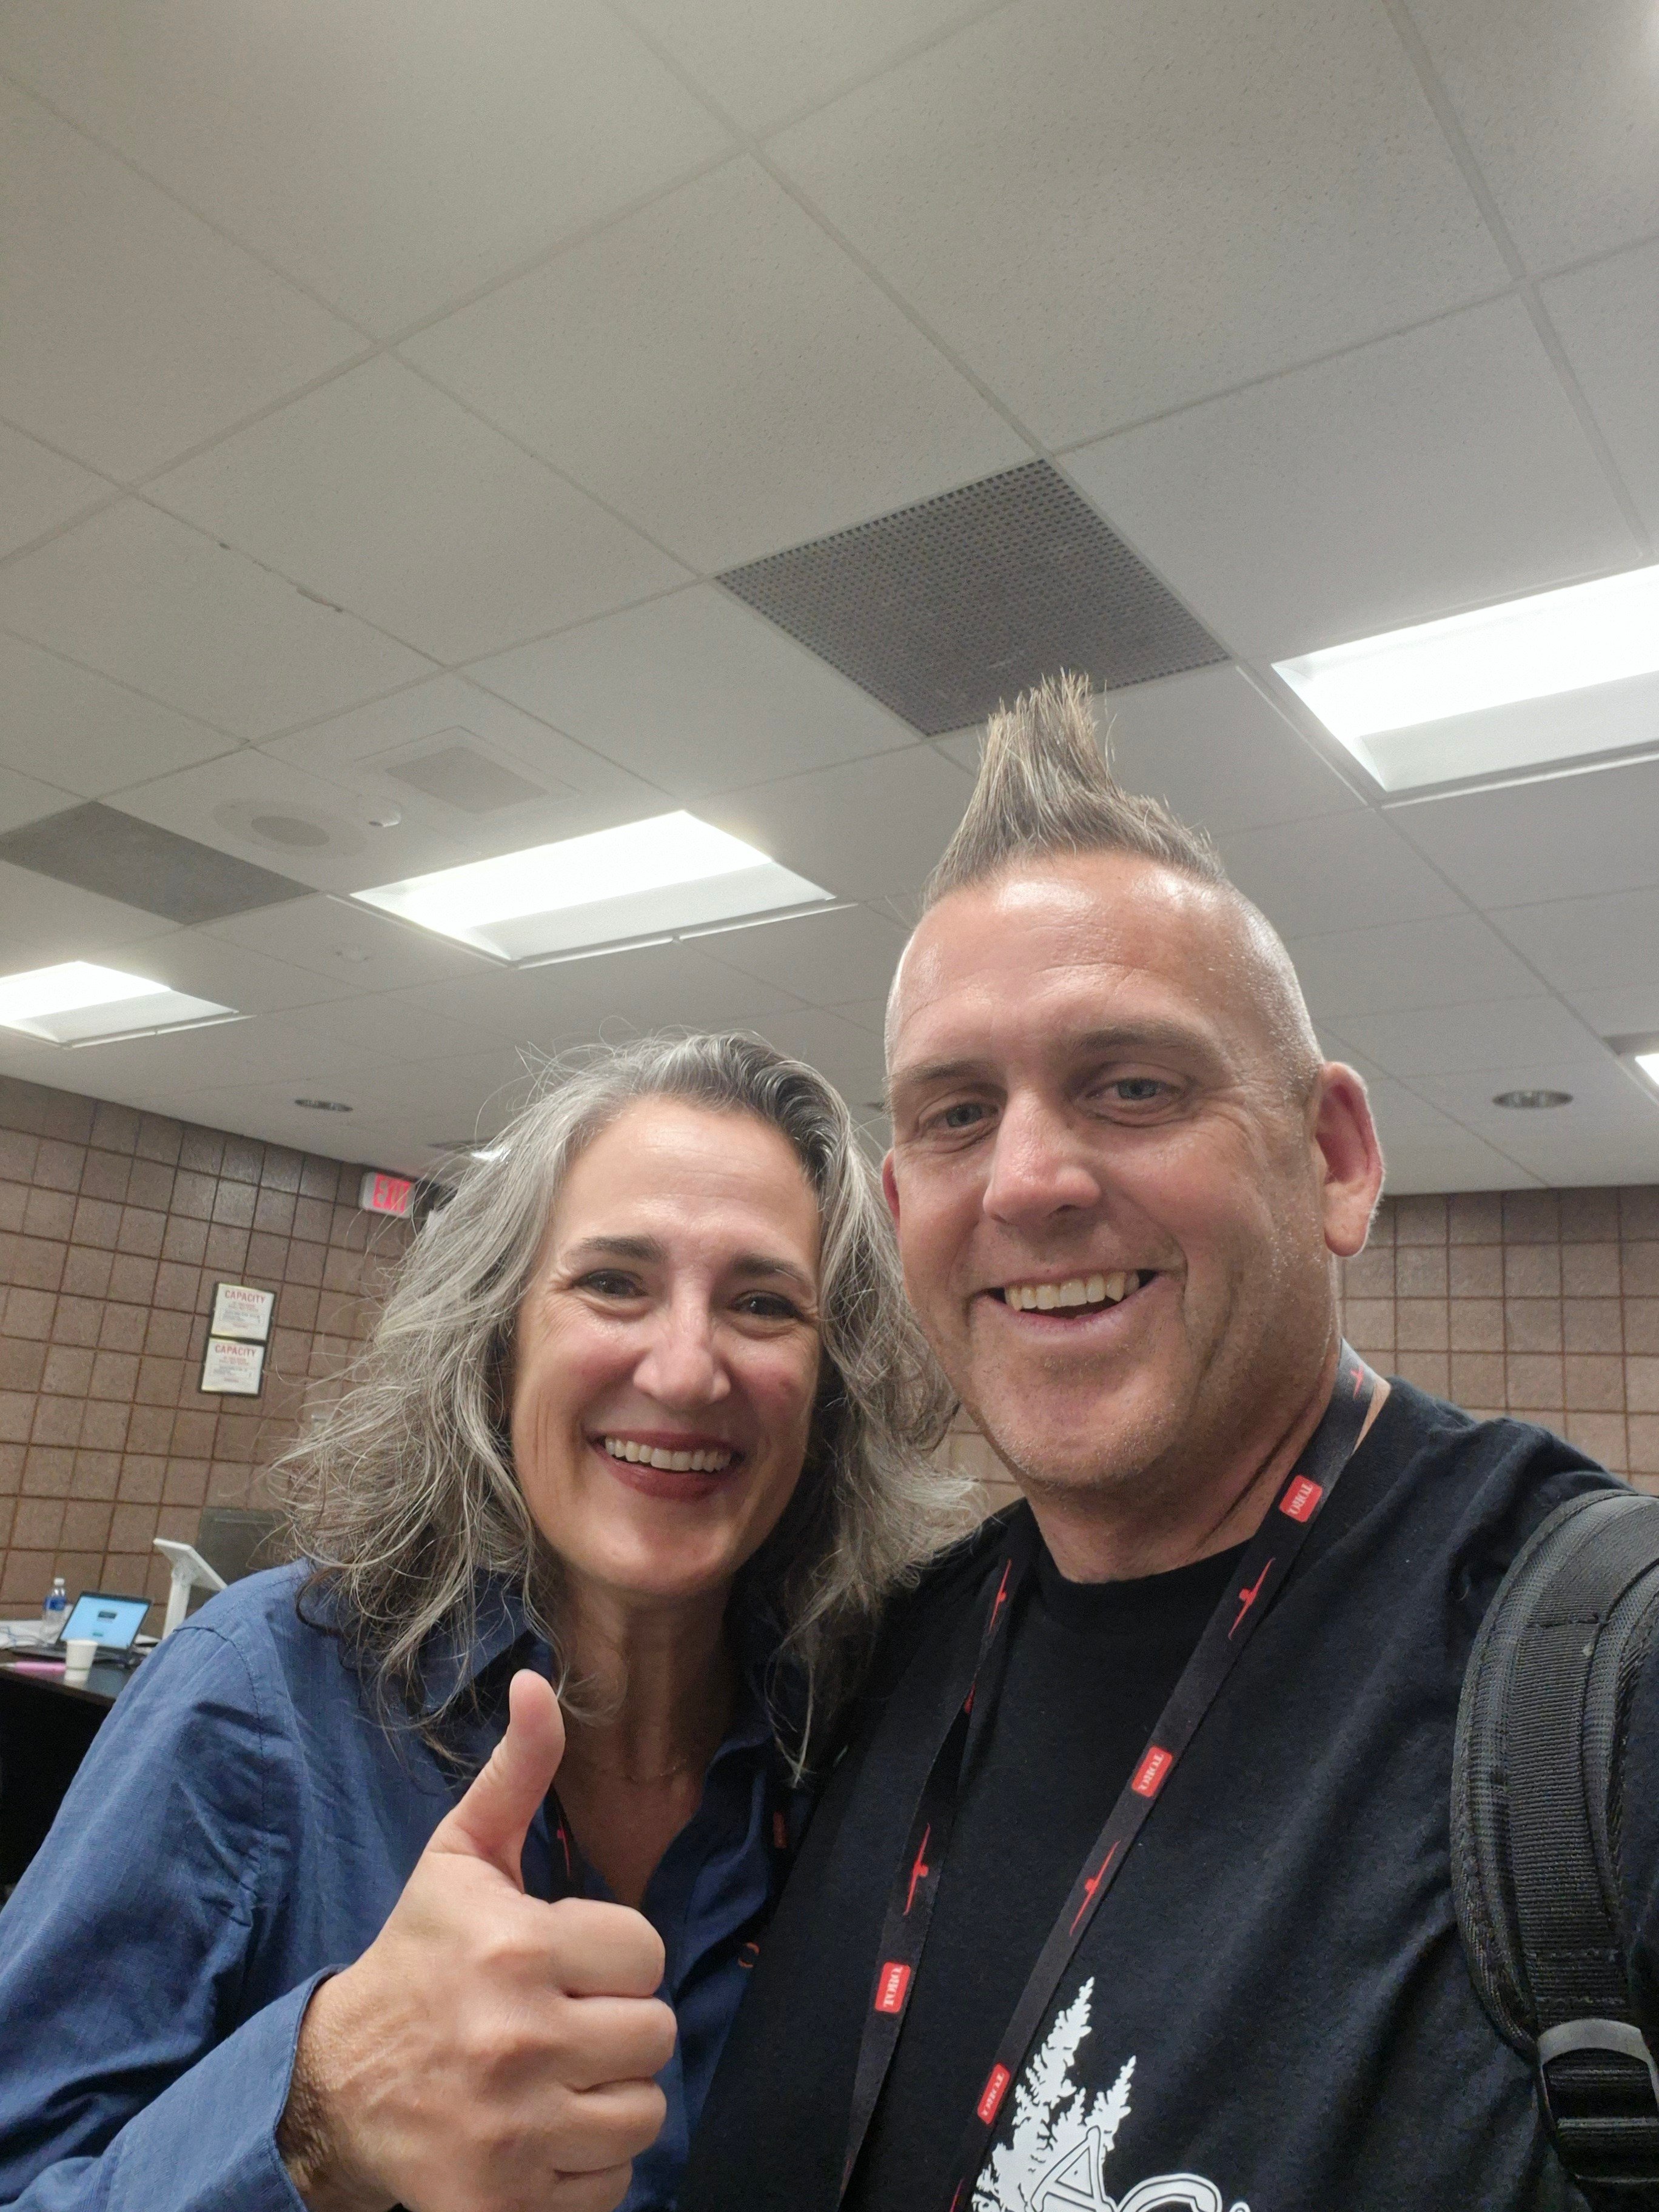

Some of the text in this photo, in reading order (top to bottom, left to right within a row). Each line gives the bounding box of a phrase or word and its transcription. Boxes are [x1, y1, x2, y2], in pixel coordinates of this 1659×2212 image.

[373, 1173, 411, 1214] EXIT
[225, 1290, 266, 1304] CAPACITY
[215, 1344, 257, 1358] CAPACITY
[1289, 1483, 1313, 1515] TORO
[883, 1966, 903, 2007] TORO
